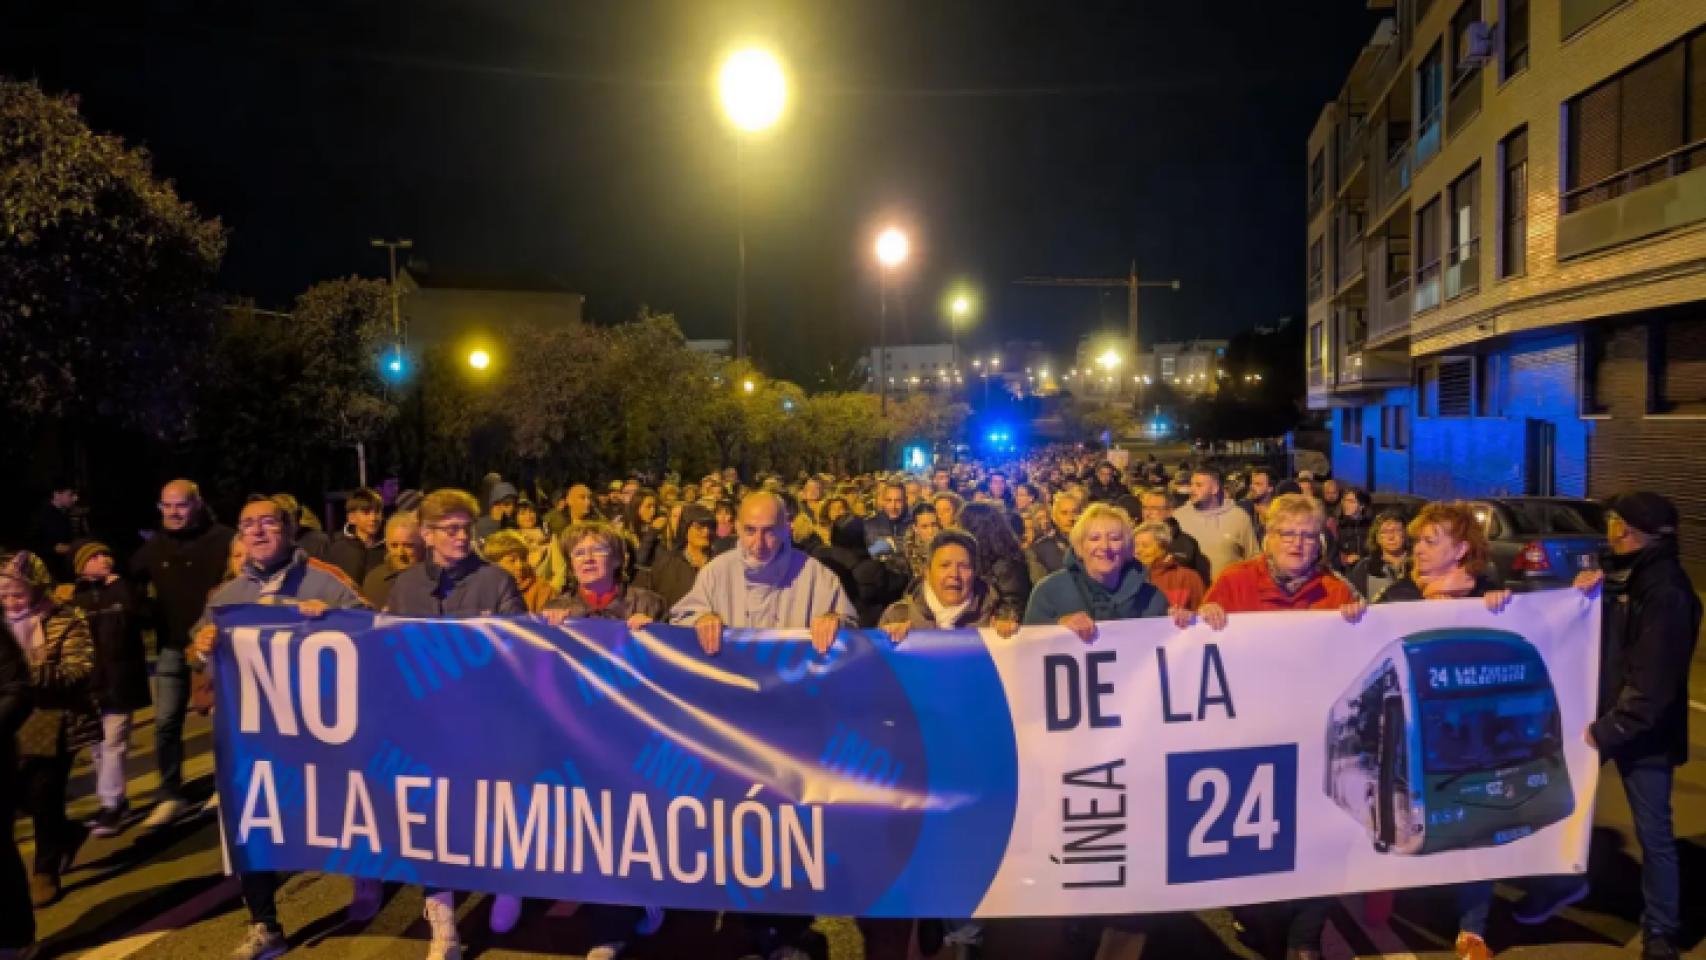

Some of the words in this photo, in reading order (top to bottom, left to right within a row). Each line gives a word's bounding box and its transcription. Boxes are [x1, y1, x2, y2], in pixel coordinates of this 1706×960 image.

[232, 627, 359, 745] NO
[1044, 650, 1122, 731] DE
[1156, 643, 1236, 723] LA
[1428, 666, 1448, 688] 24
[236, 760, 285, 845] A
[304, 763, 382, 853] LA
[395, 774, 826, 891] ELIMINACIÓN
[1050, 758, 1127, 890] LÍNEA
[1186, 763, 1281, 858] 24
